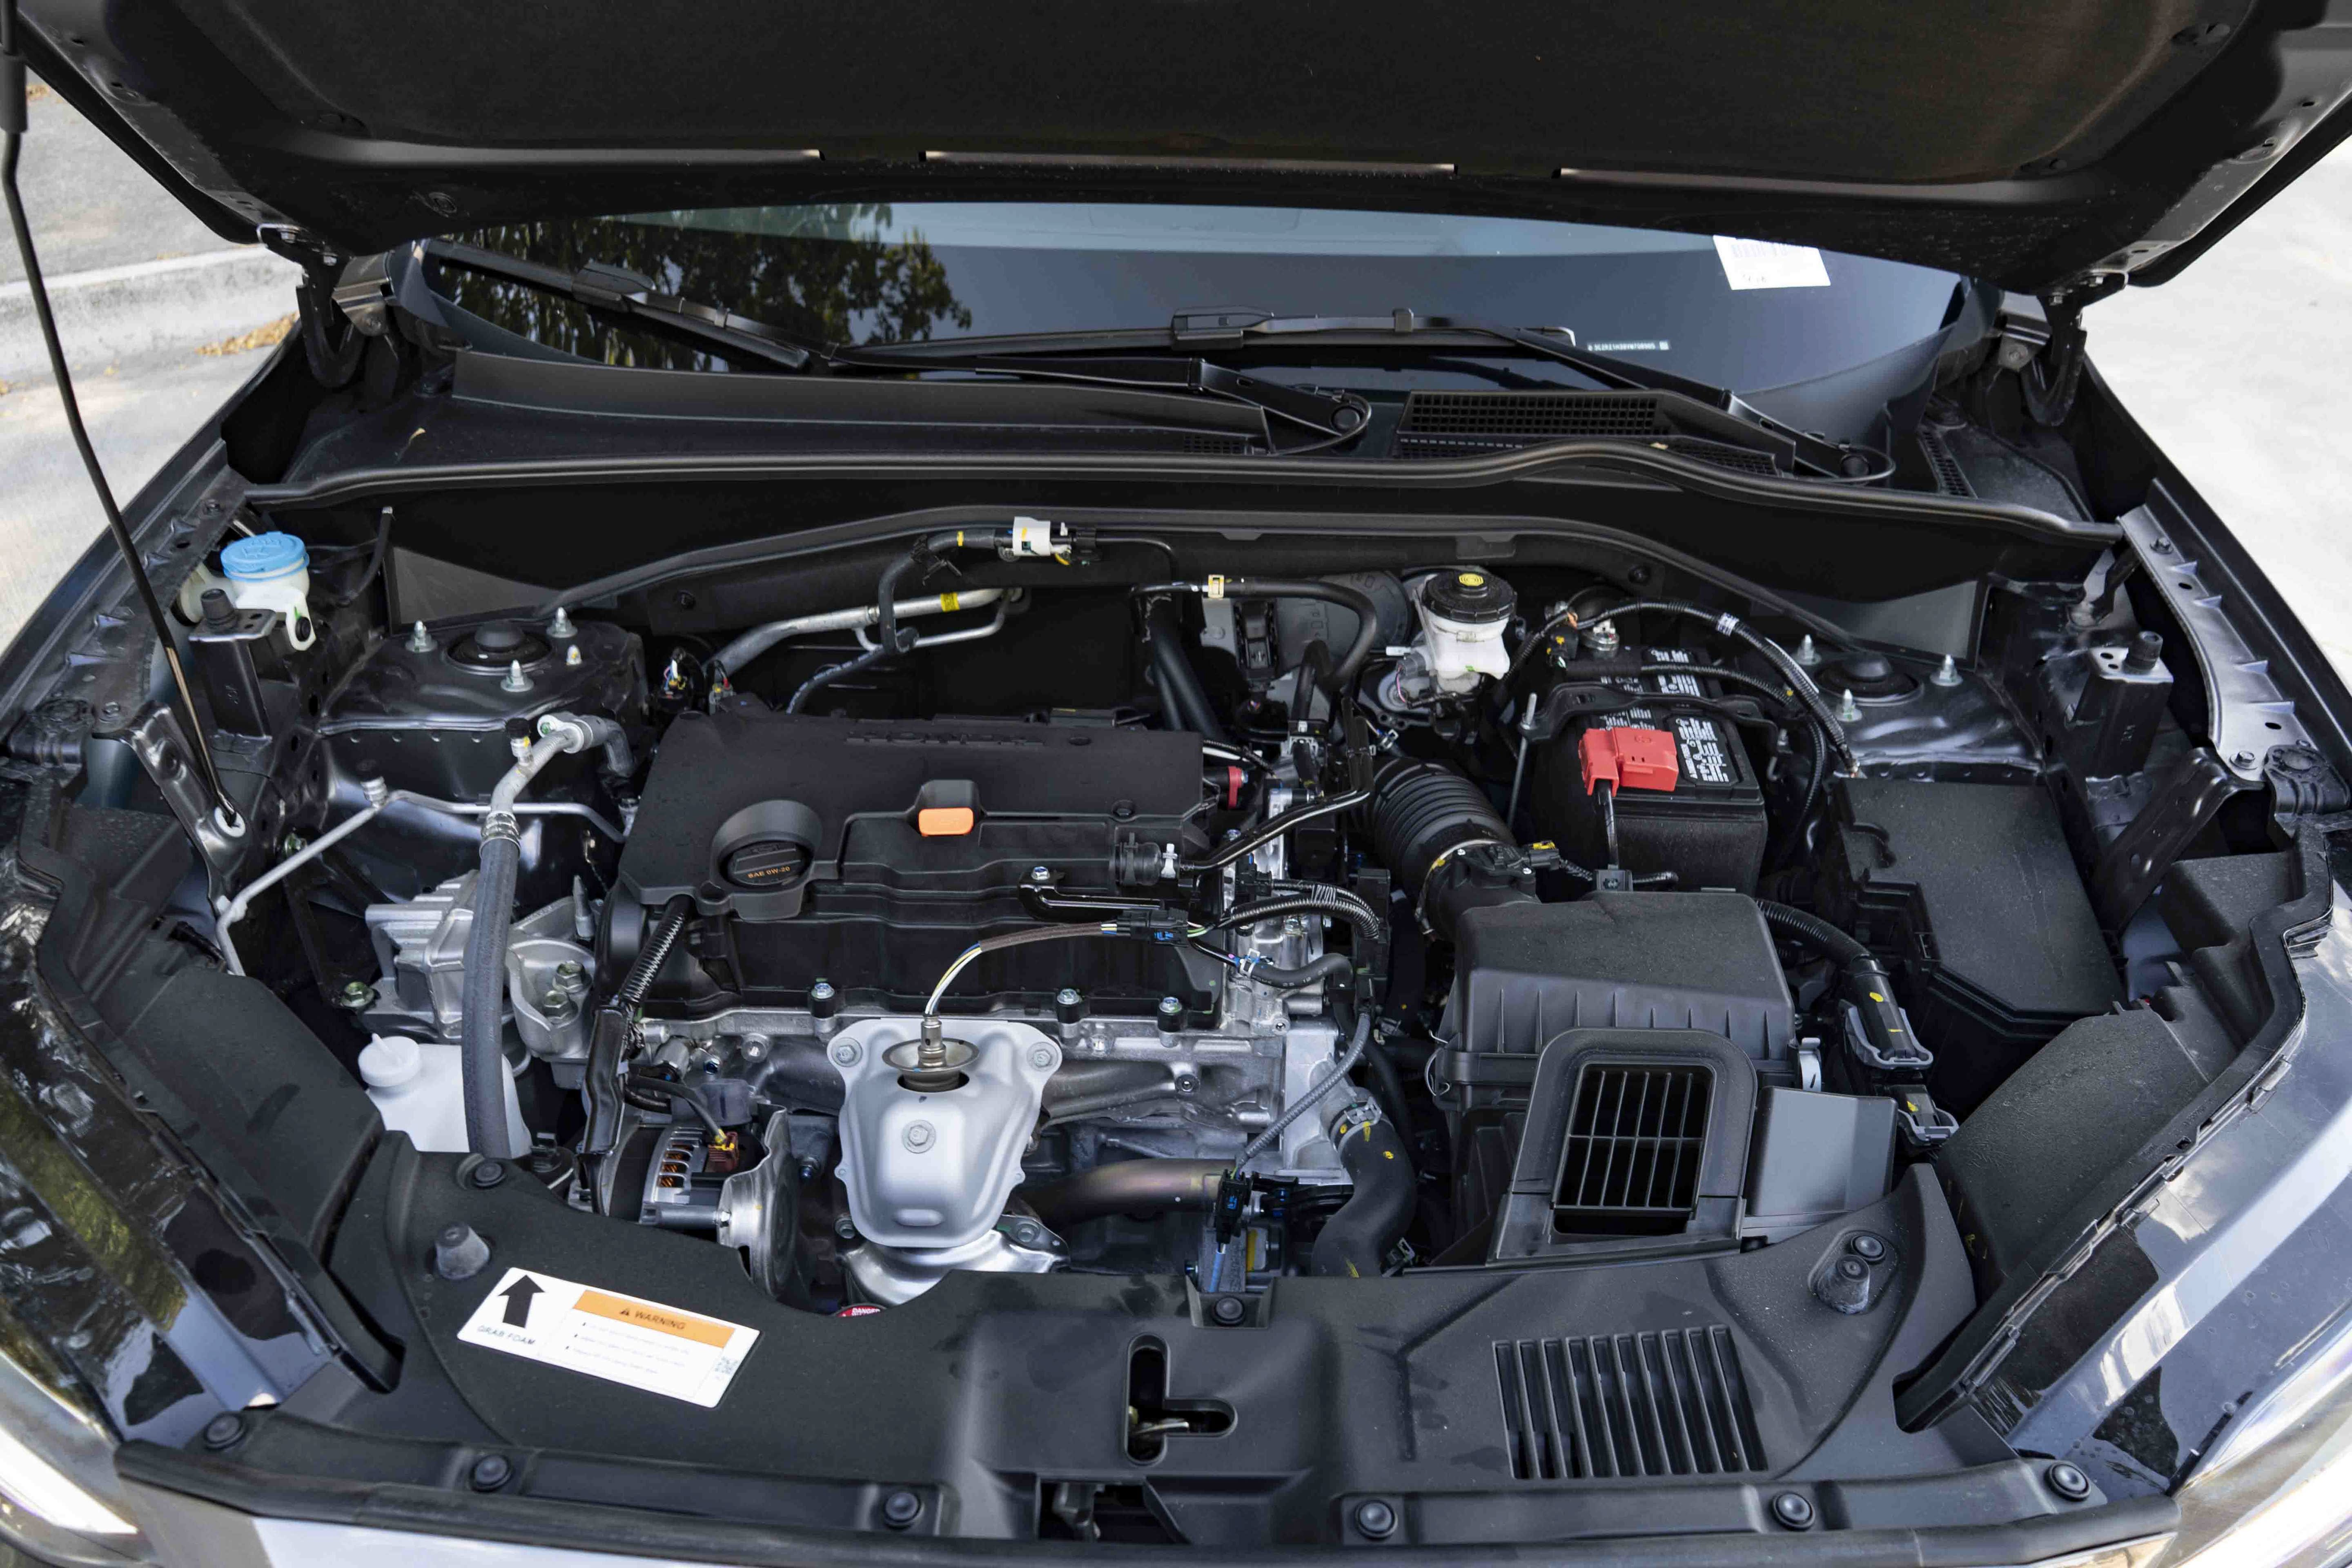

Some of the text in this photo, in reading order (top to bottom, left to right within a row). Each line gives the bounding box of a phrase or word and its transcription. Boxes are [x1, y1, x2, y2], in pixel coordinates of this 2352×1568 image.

[766, 866, 791, 875] 0W-20
[635, 1310, 686, 1330] WARNING
[477, 1325, 535, 1344] GRAB FOAM
